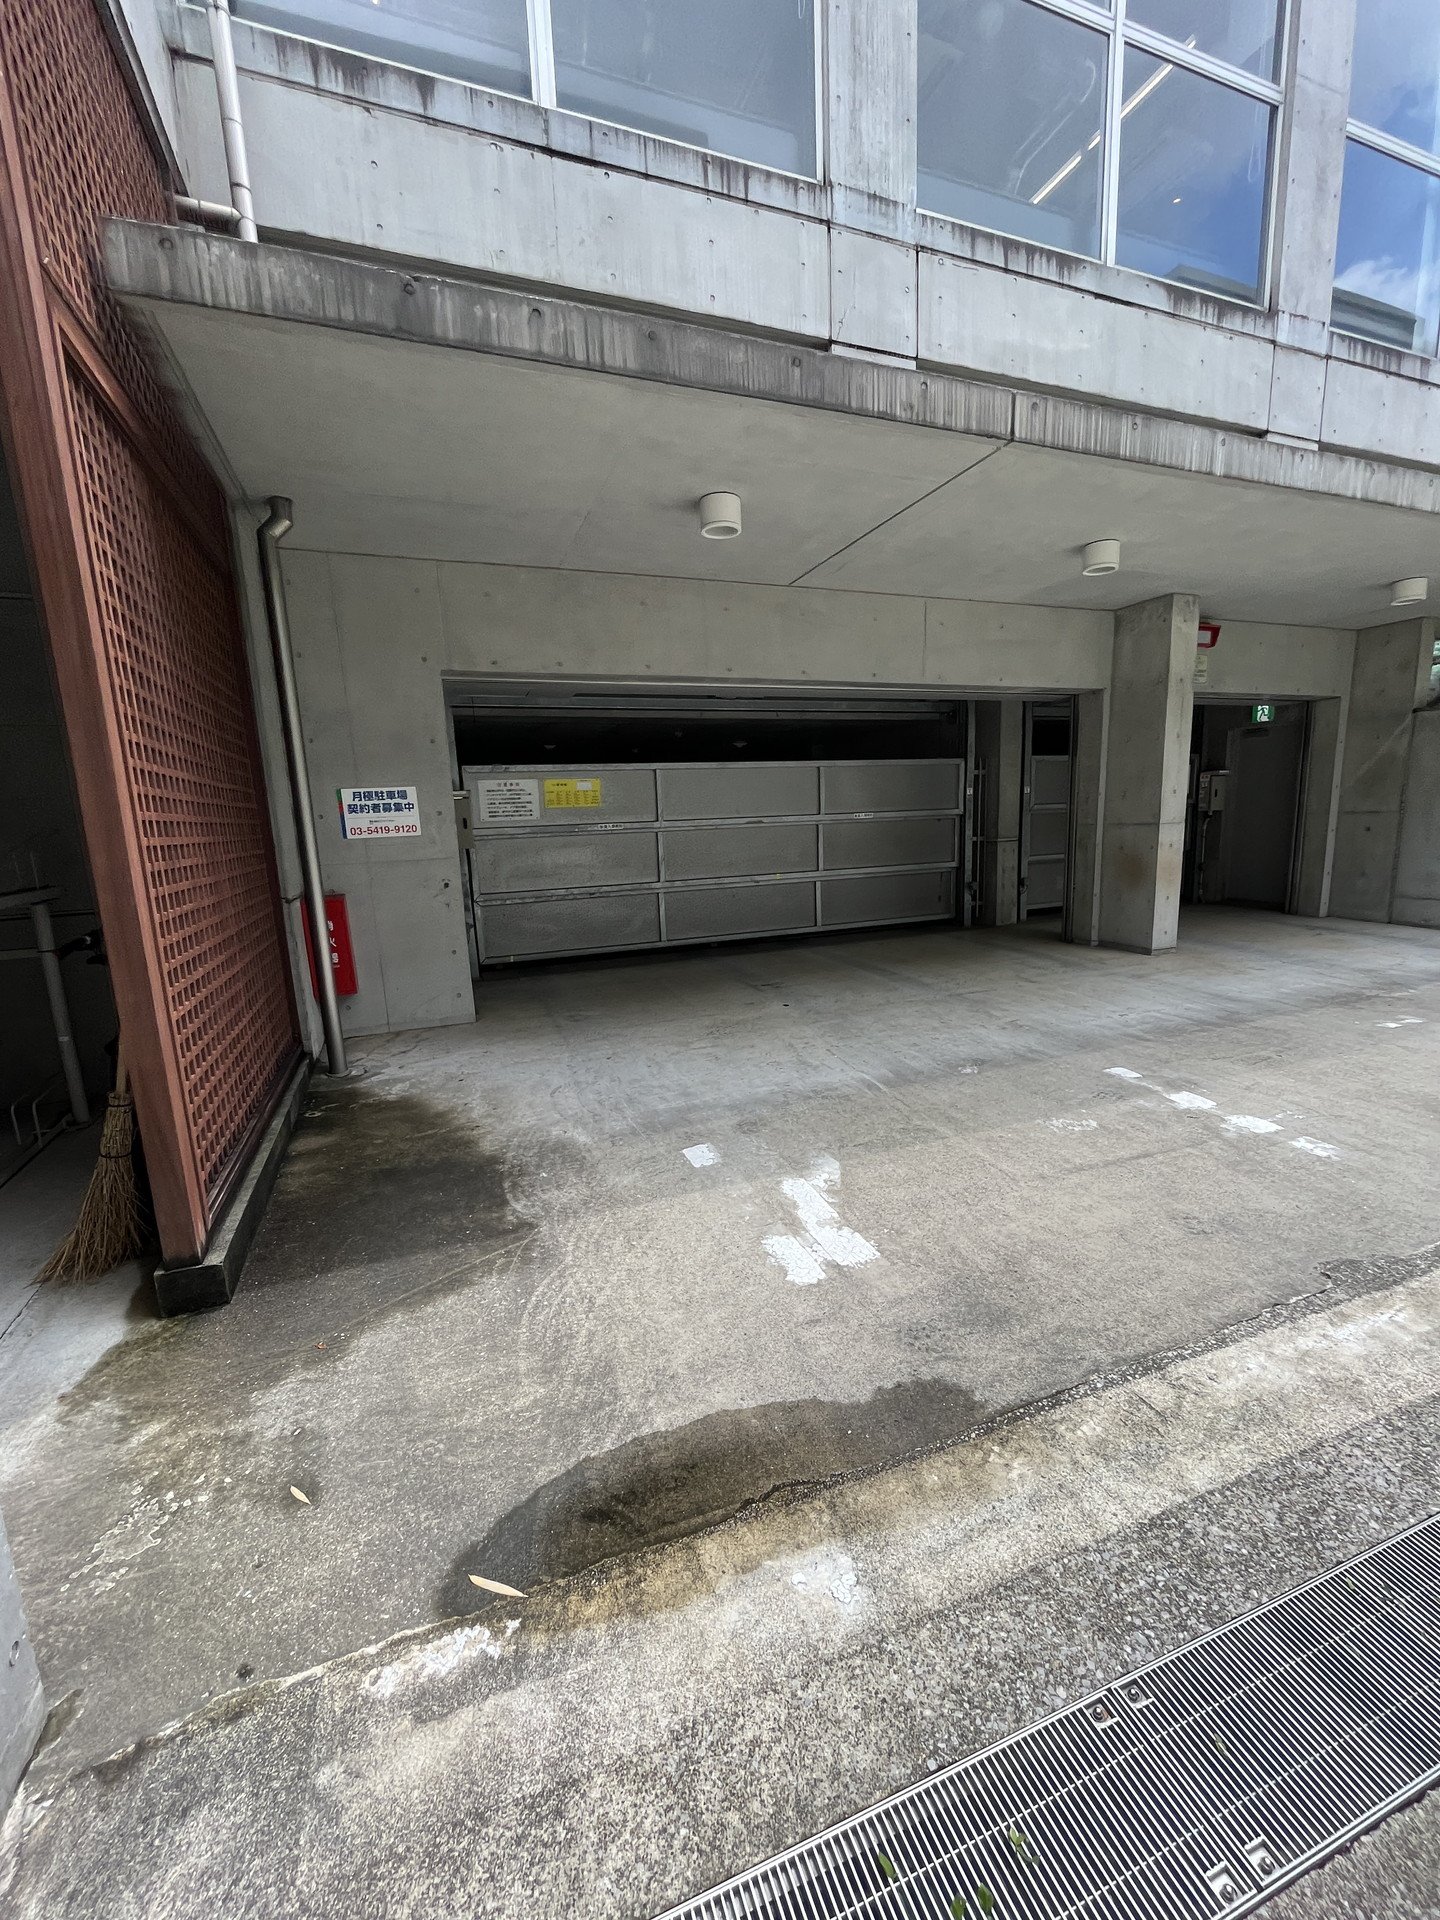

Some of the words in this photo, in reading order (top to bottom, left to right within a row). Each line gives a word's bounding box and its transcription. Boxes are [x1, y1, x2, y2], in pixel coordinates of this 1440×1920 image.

[352, 790, 408, 802] 月極駐車場
[347, 802, 415, 814] 契約者募集中
[350, 824, 418, 836] 03-5419-9120
